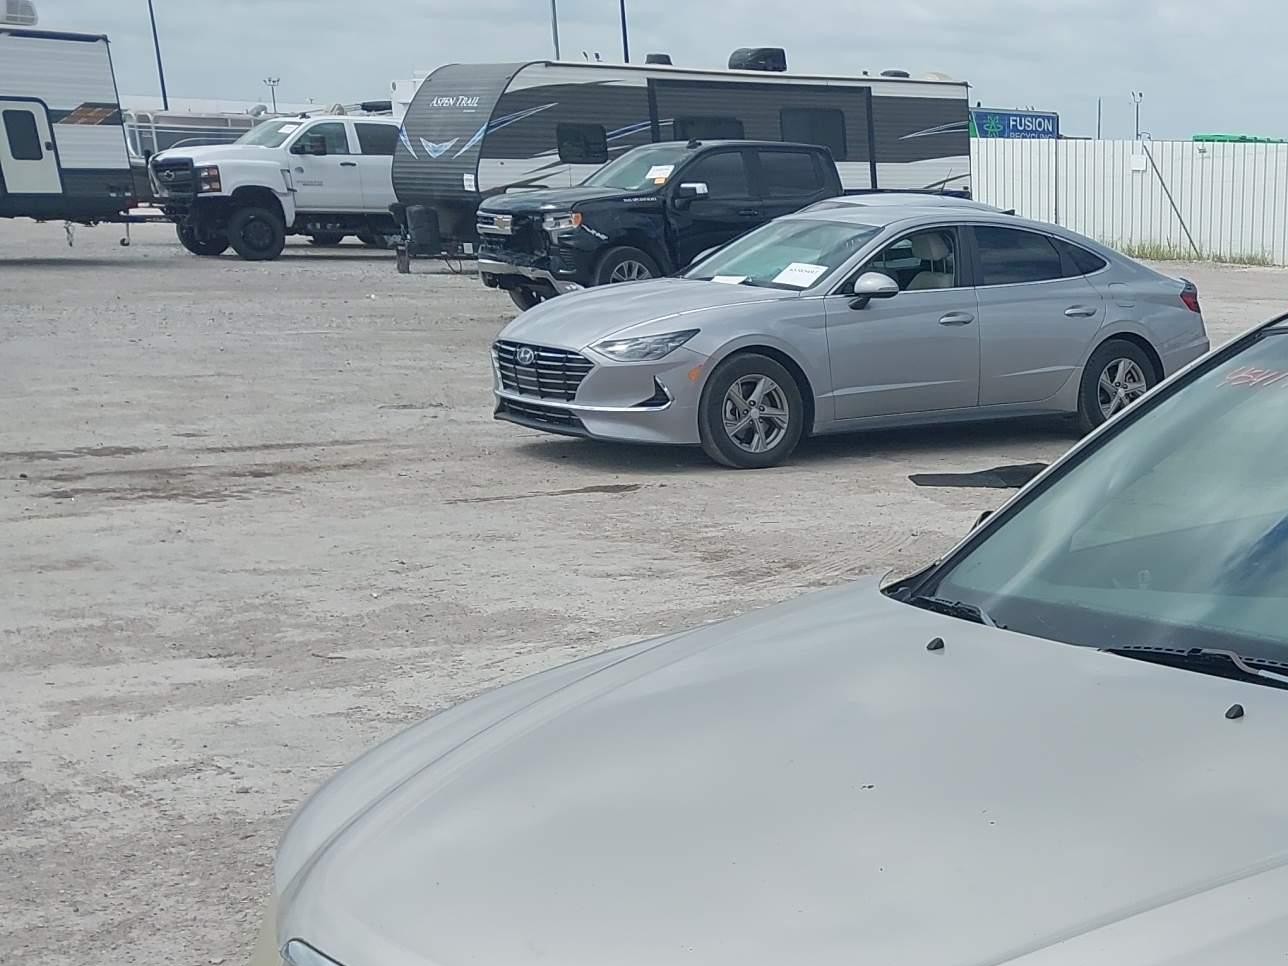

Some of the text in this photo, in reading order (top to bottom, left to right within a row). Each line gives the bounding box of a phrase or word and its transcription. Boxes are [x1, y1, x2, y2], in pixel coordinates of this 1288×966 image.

[430, 96, 480, 107] ASPEN TRAIL
[1009, 116, 1053, 132] FUSION
